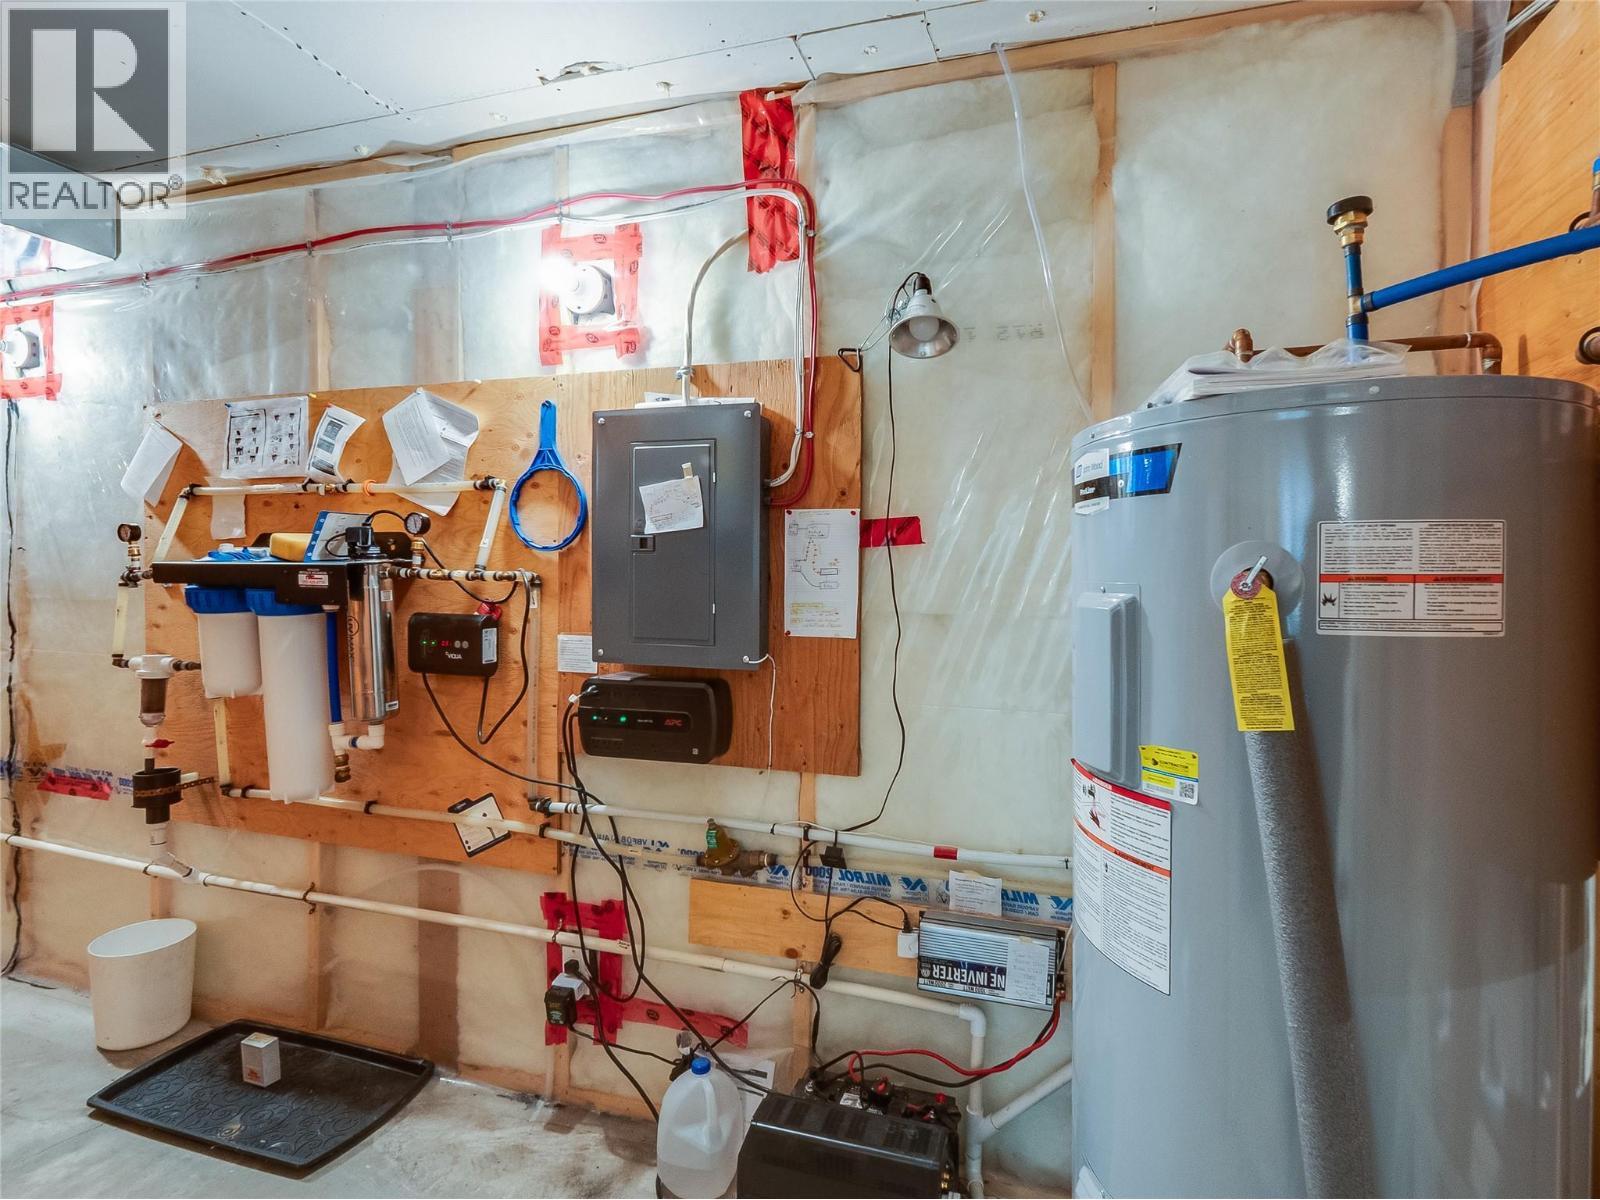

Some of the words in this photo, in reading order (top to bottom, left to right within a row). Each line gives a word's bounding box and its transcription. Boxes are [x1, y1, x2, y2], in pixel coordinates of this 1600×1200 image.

[664, 719, 684, 727] APC
[932, 964, 988, 986] INVERTER
[990, 973, 1005, 989] NE
